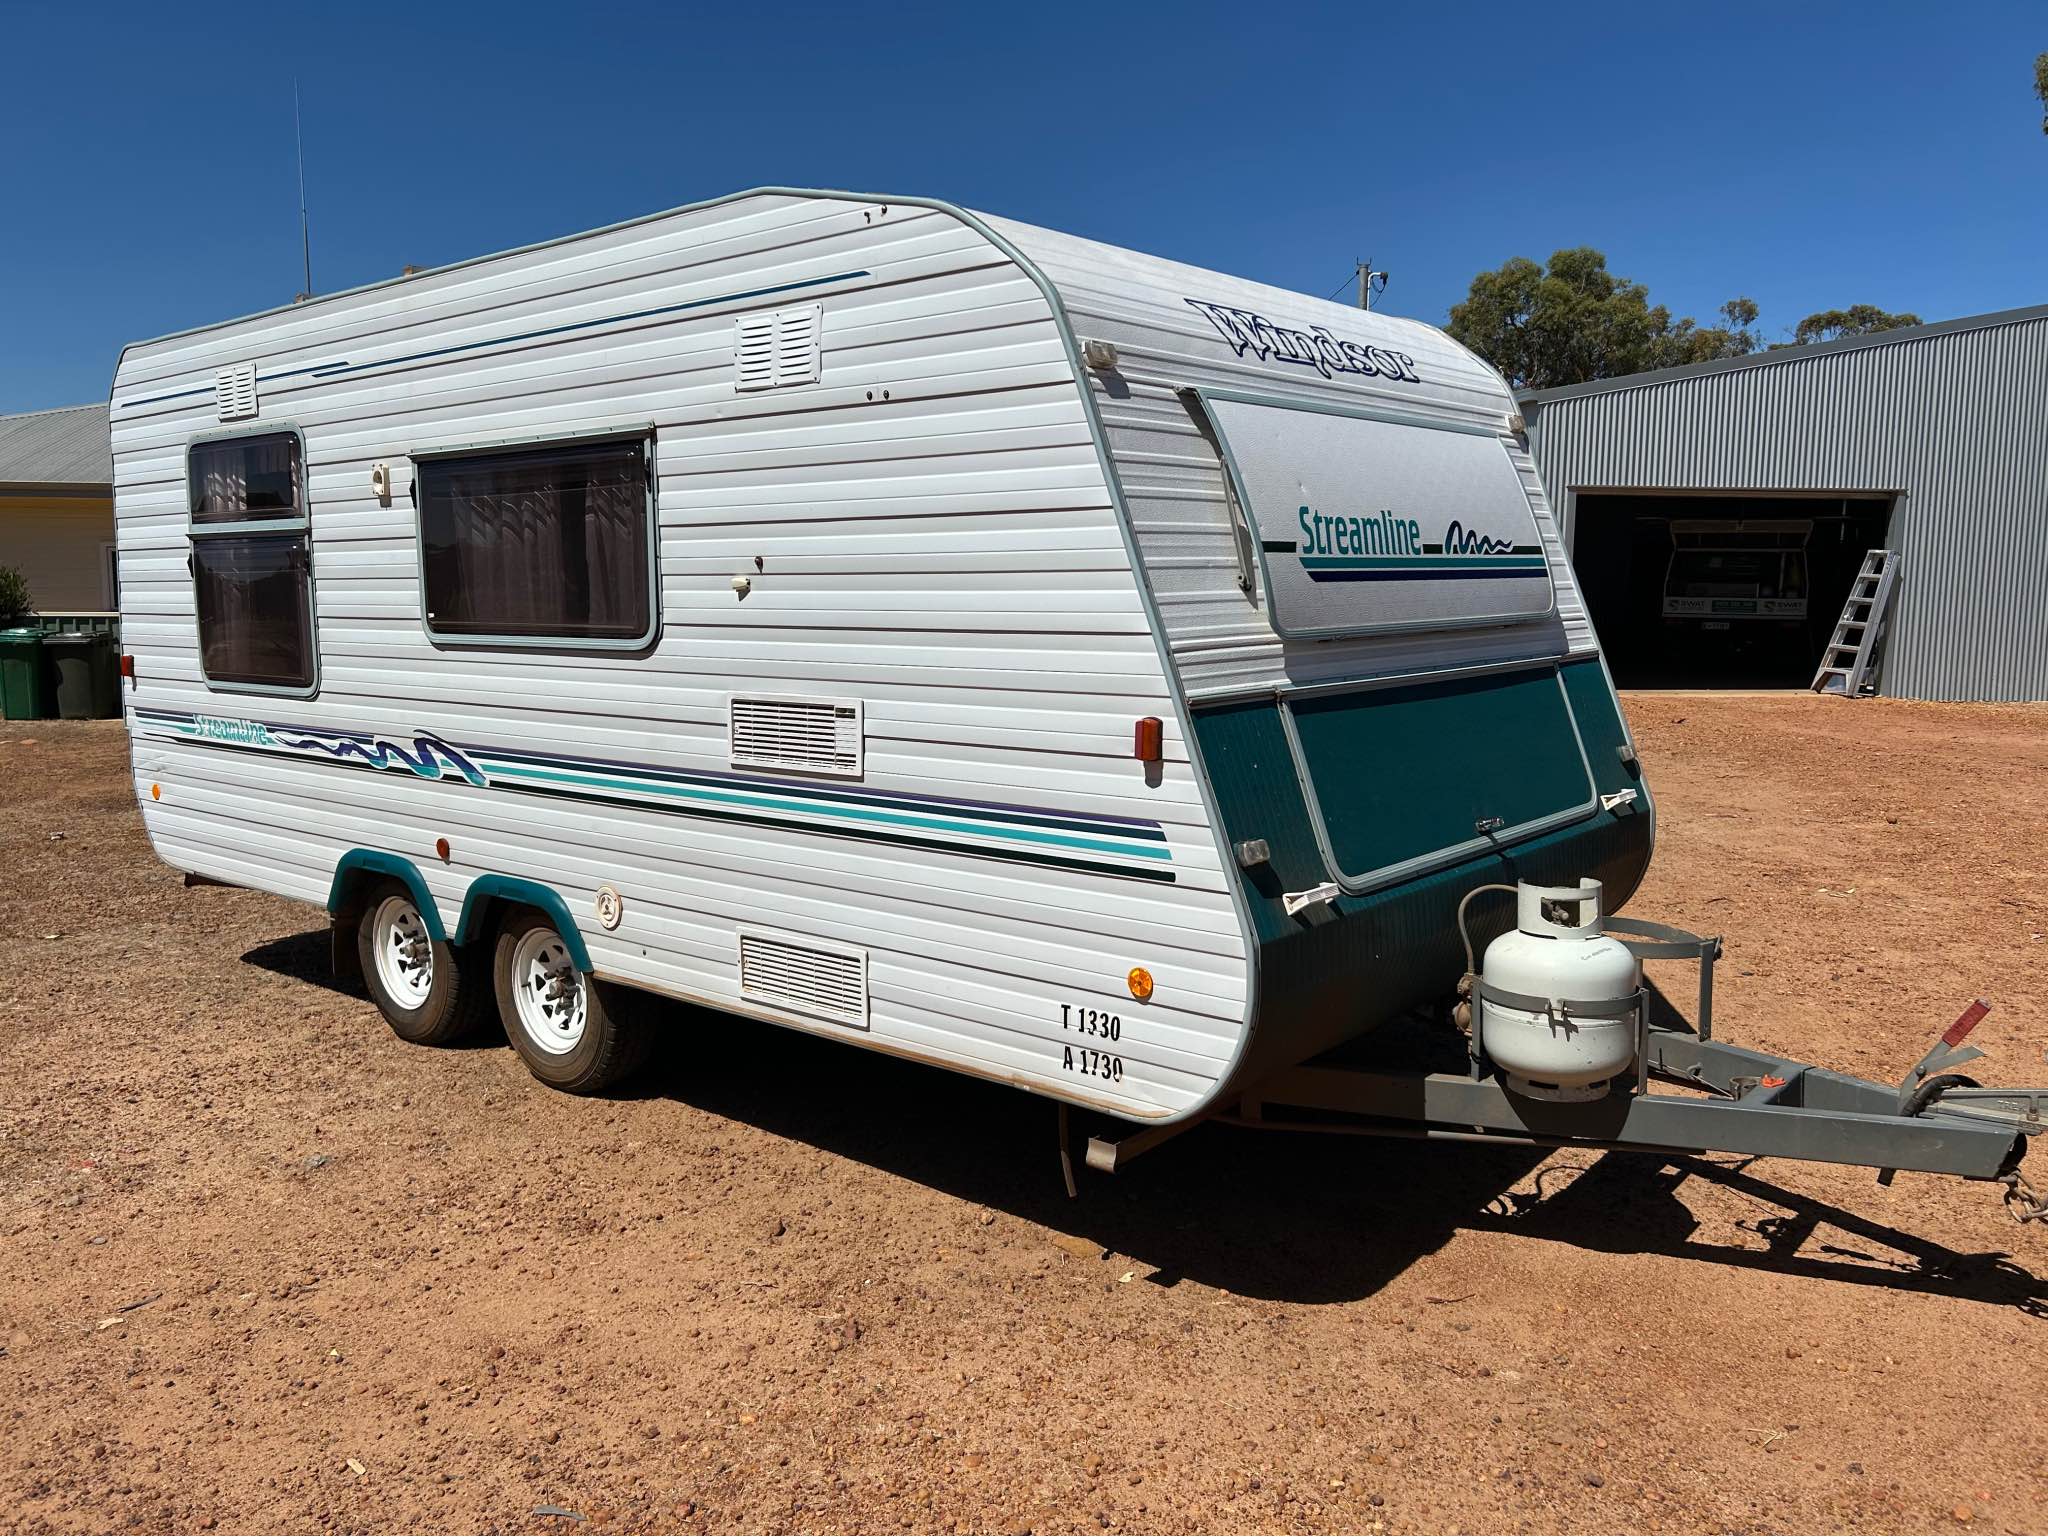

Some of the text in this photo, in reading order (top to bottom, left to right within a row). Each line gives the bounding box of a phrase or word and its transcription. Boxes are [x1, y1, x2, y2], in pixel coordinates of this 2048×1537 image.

[1184, 298, 1421, 383] Windsor
[1299, 506, 1421, 555] Streamline
[193, 713, 267, 745] Streamline
[1061, 1004, 1121, 1041] T 1330
[1063, 1046, 1123, 1082] A 1730
